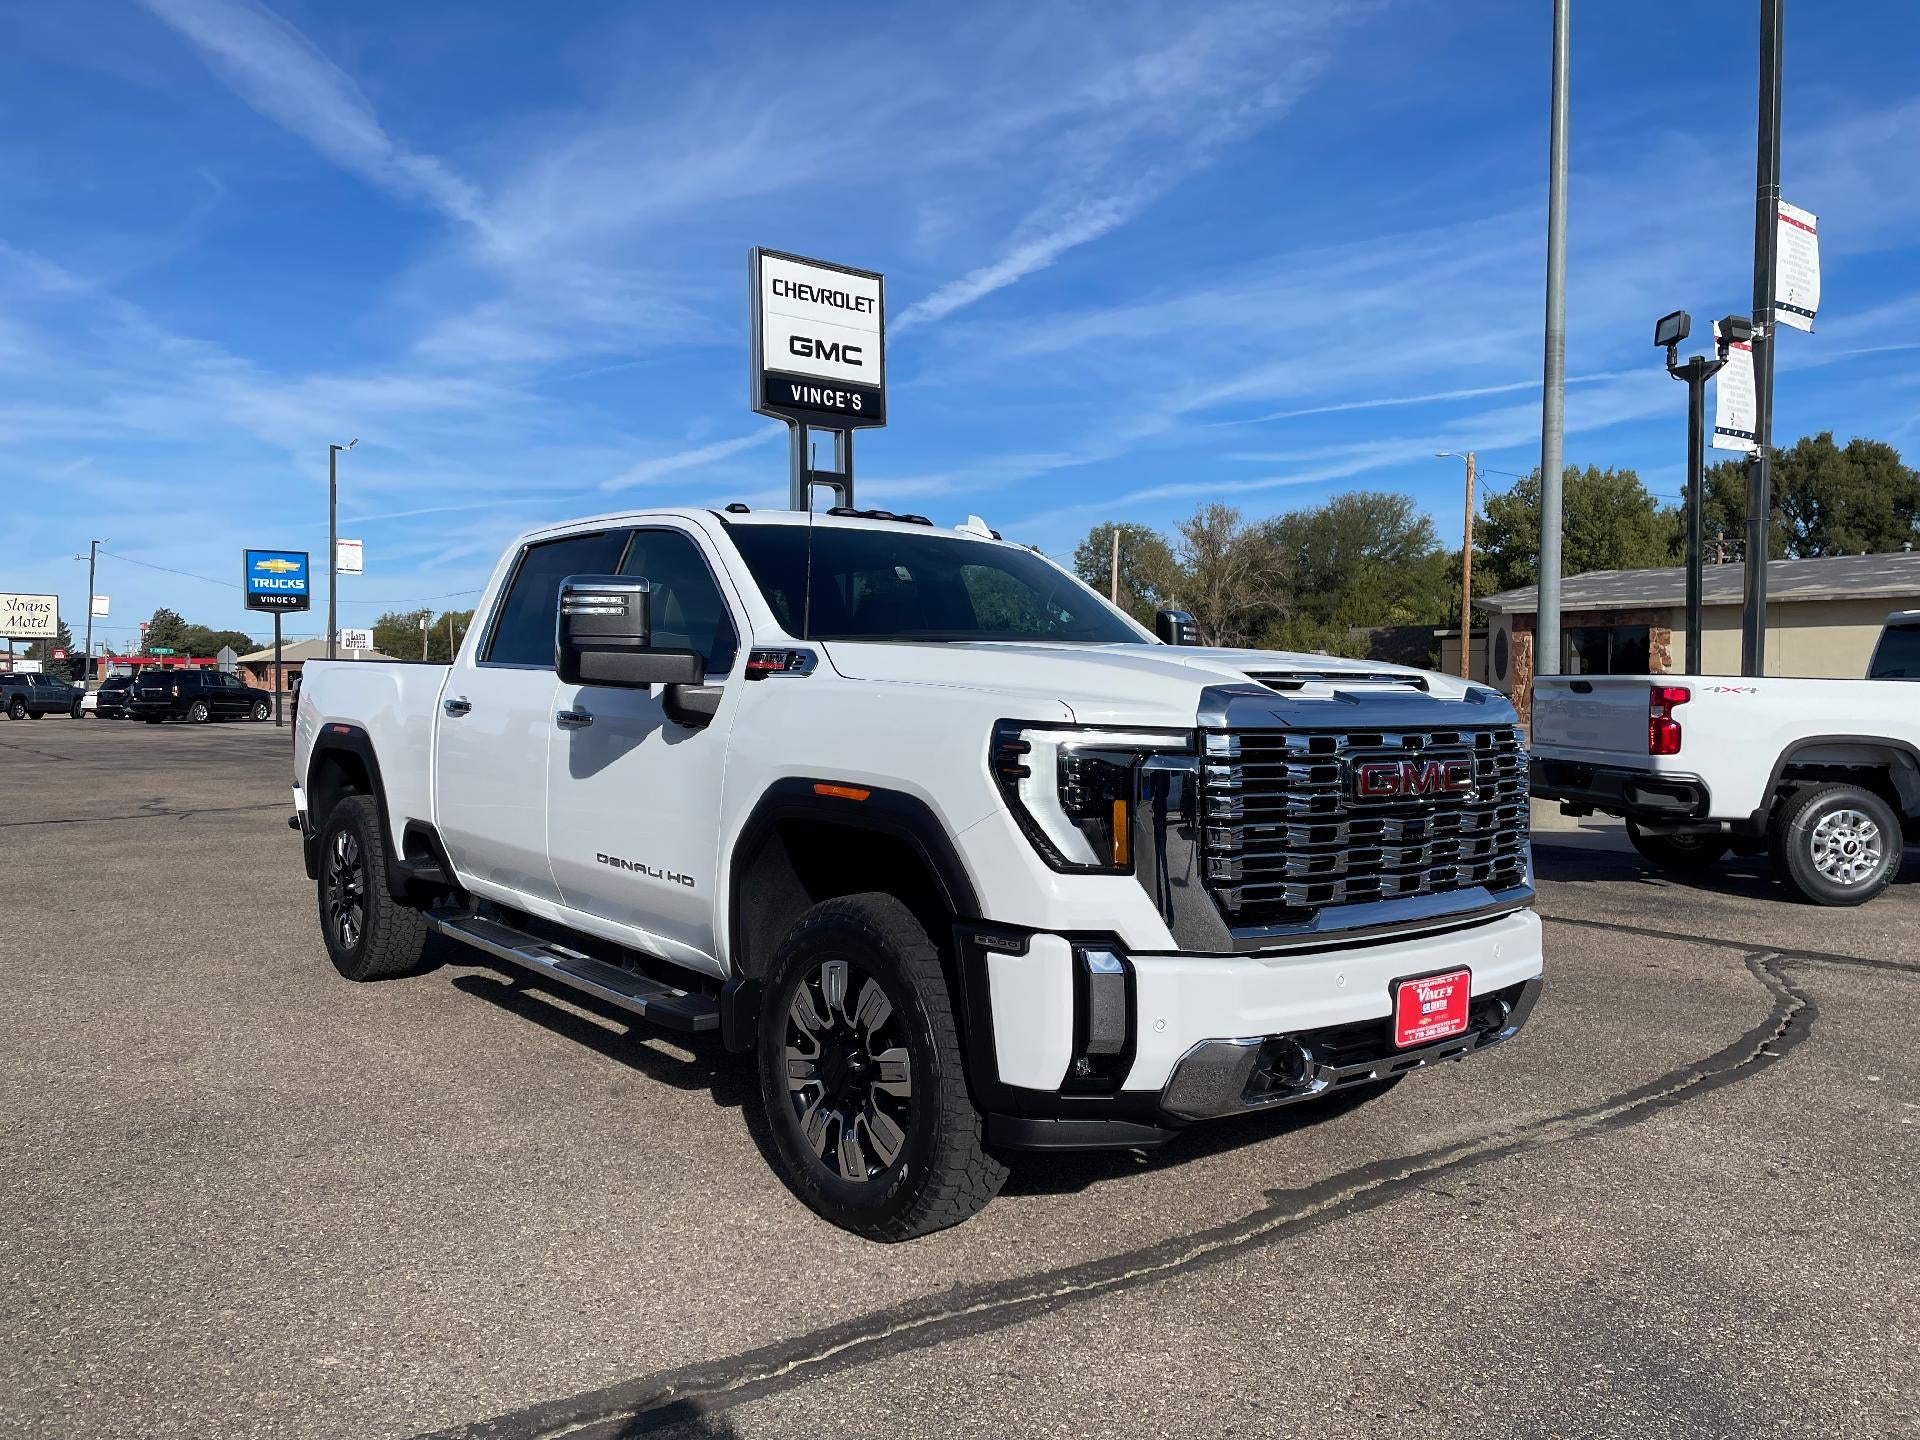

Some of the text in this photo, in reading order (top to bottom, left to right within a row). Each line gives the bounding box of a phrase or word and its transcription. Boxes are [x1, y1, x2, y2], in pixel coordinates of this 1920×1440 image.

[772, 278, 875, 314] CHEVROLET
[789, 335, 863, 367] GMC
[790, 384, 862, 410] VINCE'S
[252, 578, 304, 588] TRUCKS
[4, 597, 51, 612] Sloans
[260, 596, 297, 604] VINCE'S
[5, 615, 49, 628] Motel
[1357, 760, 1472, 796] GMC
[596, 853, 696, 888] DENALI HD
